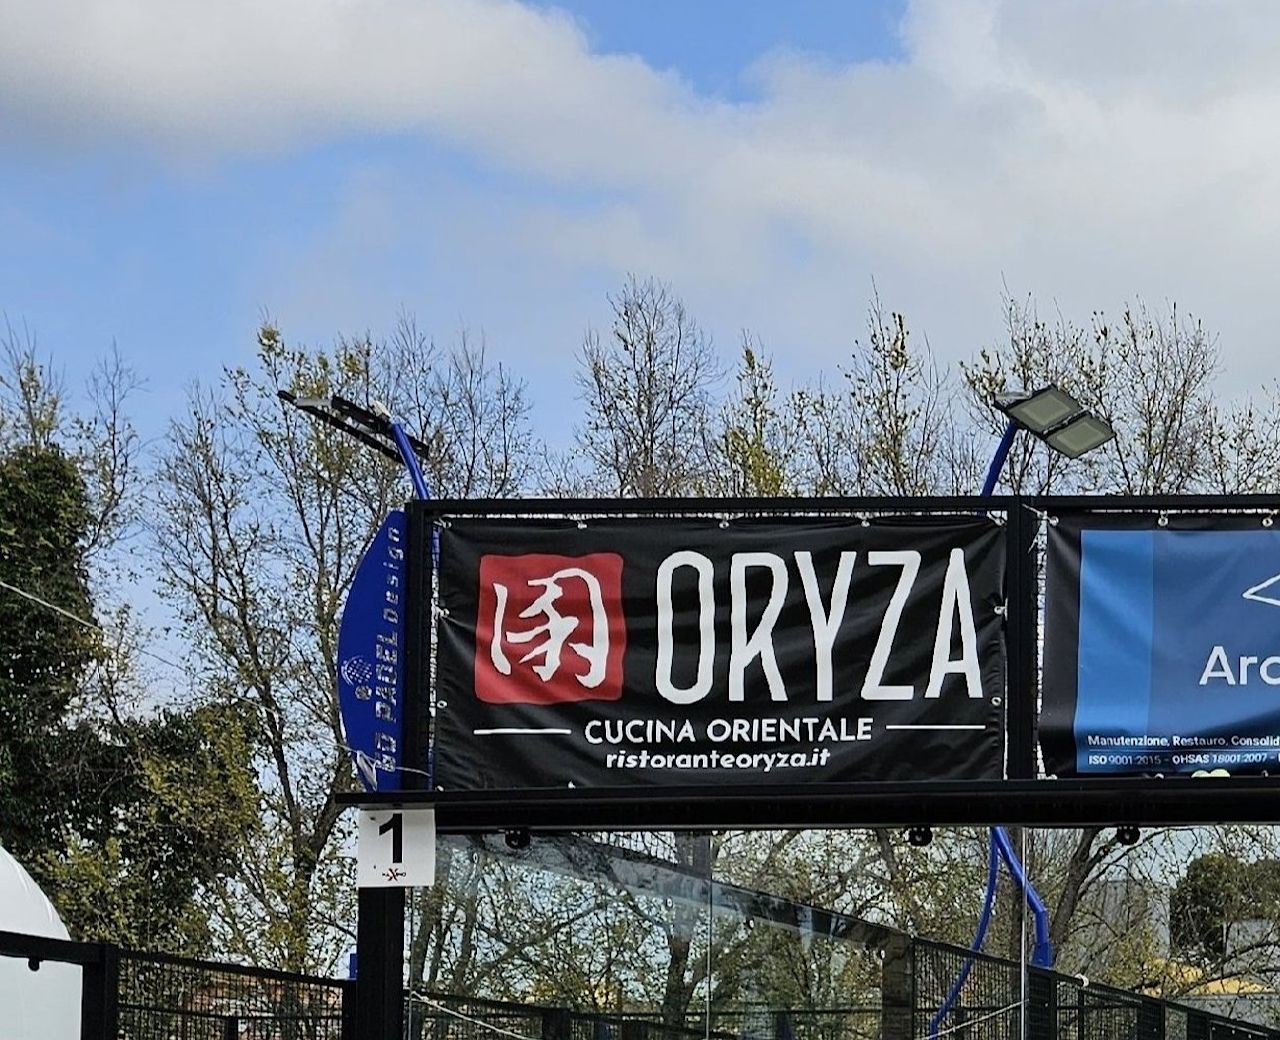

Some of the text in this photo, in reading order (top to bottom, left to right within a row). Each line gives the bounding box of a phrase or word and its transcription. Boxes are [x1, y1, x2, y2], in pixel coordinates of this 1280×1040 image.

[656, 548, 984, 704] ORYZA
[584, 717, 874, 744] CUCINA ORIENTALE
[606, 748, 831, 772] ristoranteoryza.it
[1088, 755, 1107, 765] ISO
[1172, 753, 1210, 765] OHSAS
[378, 813, 403, 864] 1
